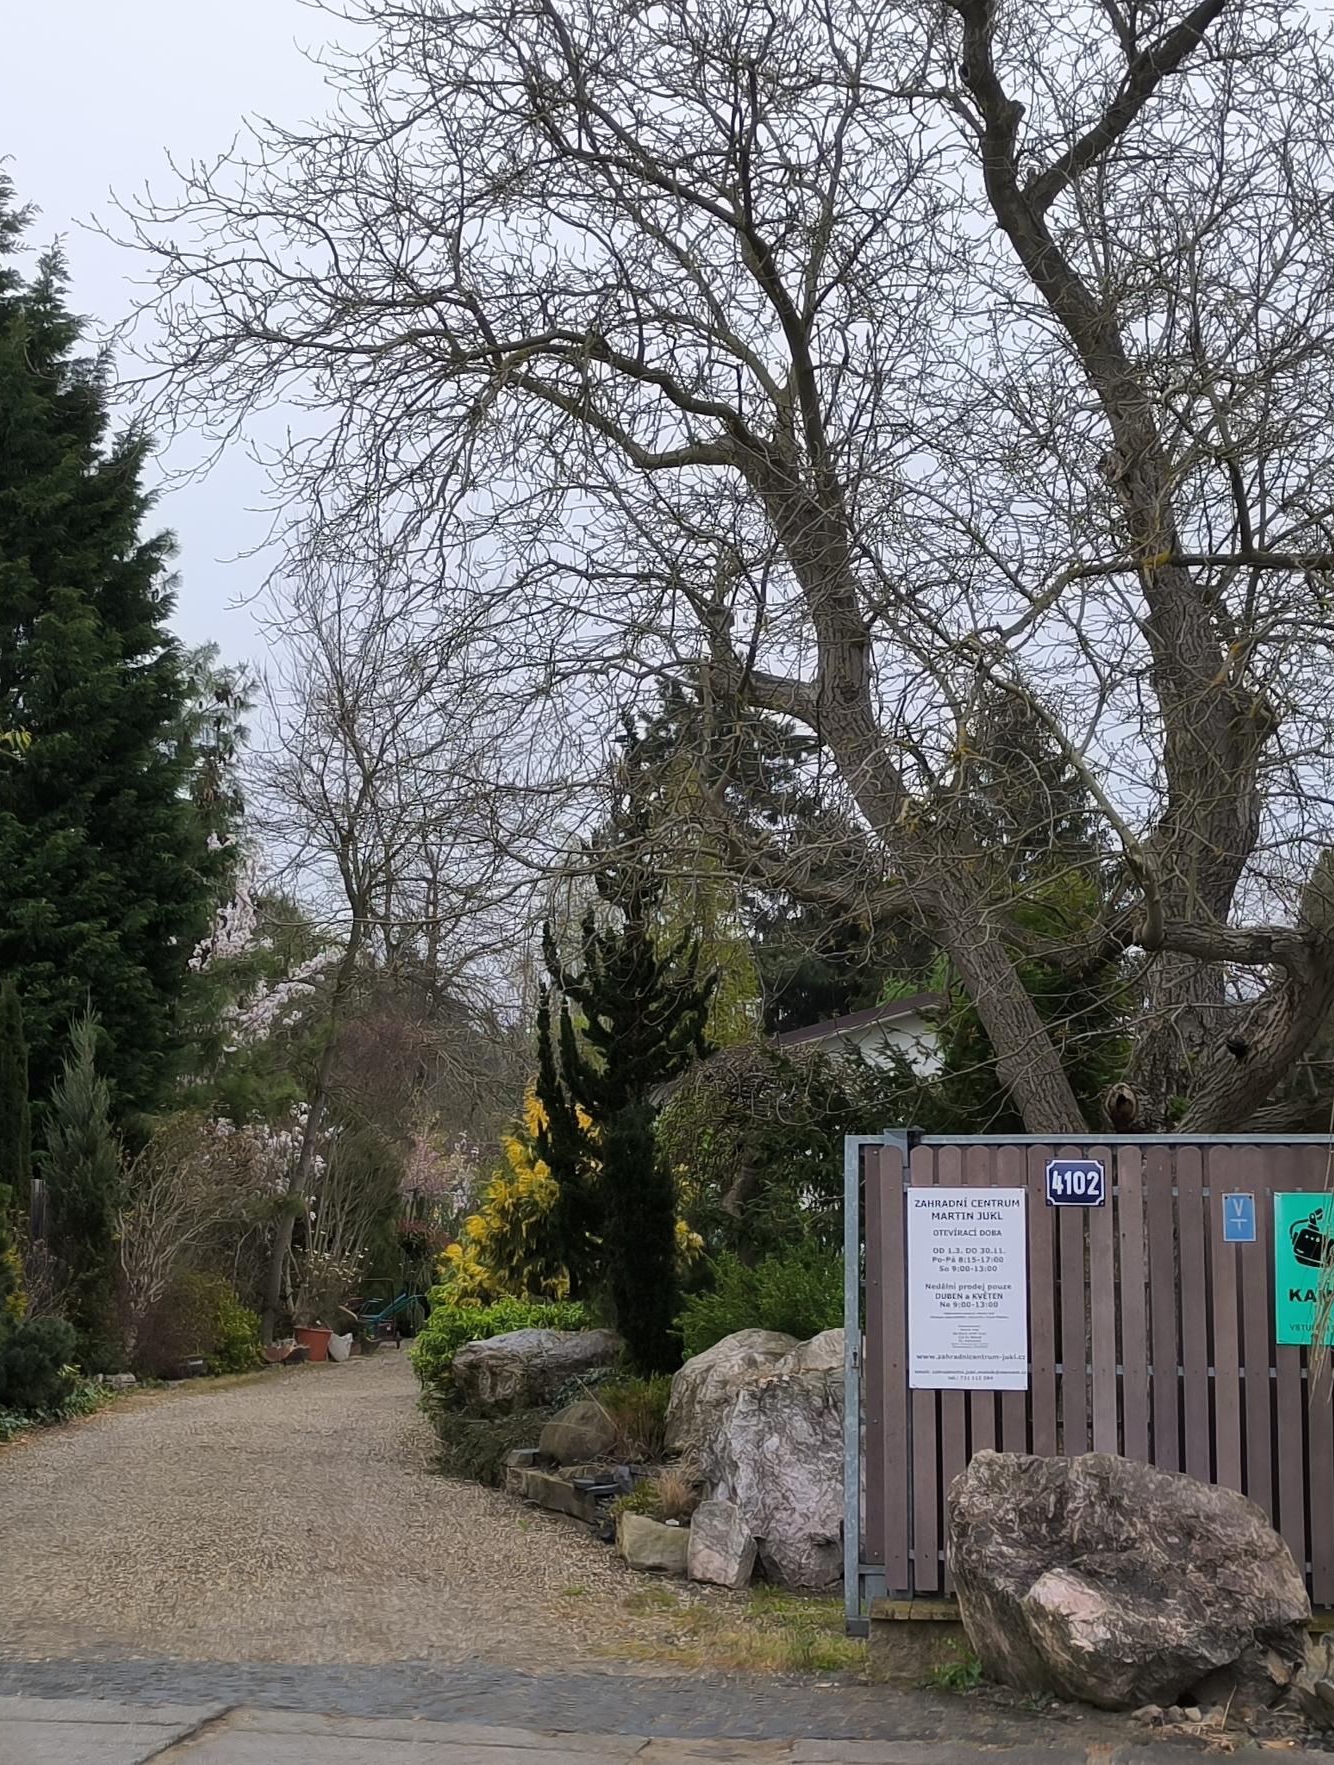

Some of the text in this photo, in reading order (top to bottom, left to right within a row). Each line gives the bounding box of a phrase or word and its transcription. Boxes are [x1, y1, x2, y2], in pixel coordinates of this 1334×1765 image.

[1052, 1170, 1100, 1195] 4102
[914, 1197, 1020, 1208] ZAHRADNÍ CENTRUM
[931, 1212, 1003, 1220] MARTIN JUKL
[932, 1227, 1002, 1237] OTEVÍRACÍ DOBA
[958, 1284, 985, 1292] prodej
[972, 1291, 1003, 1300] KVĚTEN
